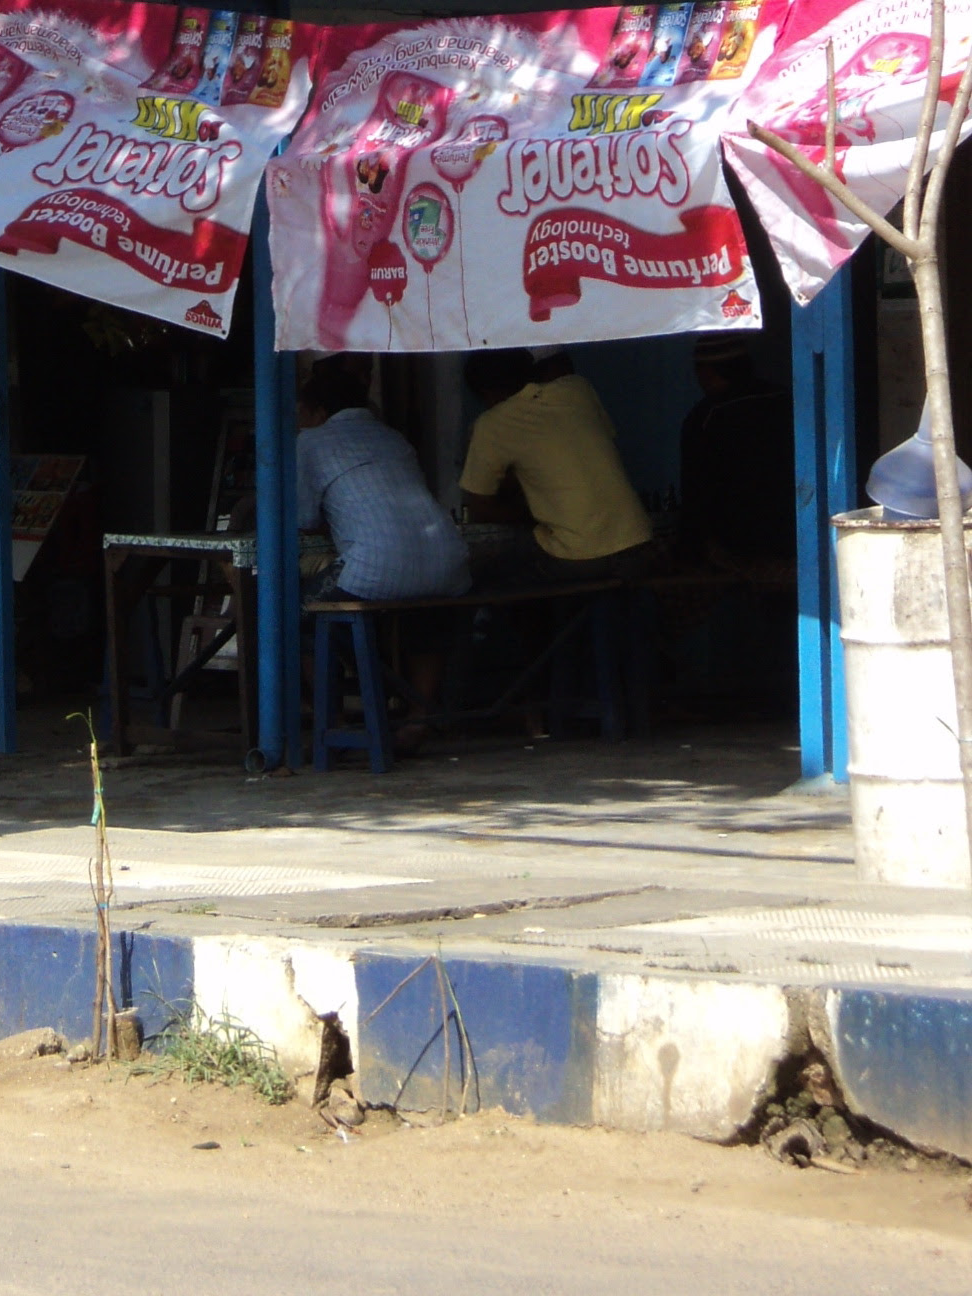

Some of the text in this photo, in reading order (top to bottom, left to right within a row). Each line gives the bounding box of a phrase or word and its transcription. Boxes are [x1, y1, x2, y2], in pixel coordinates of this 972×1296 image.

[395, 38, 433, 62] yang
[360, 65, 388, 94] dan
[32, 122, 243, 213] Softener
[435, 153, 470, 165] Perfume
[497, 120, 695, 217] Softener
[42, 191, 132, 232] technology
[23, 208, 225, 286] Perfume Booster
[530, 219, 630, 249] technology
[528, 241, 732, 284] Perfume Booster
[185, 311, 223, 330] WINGS
